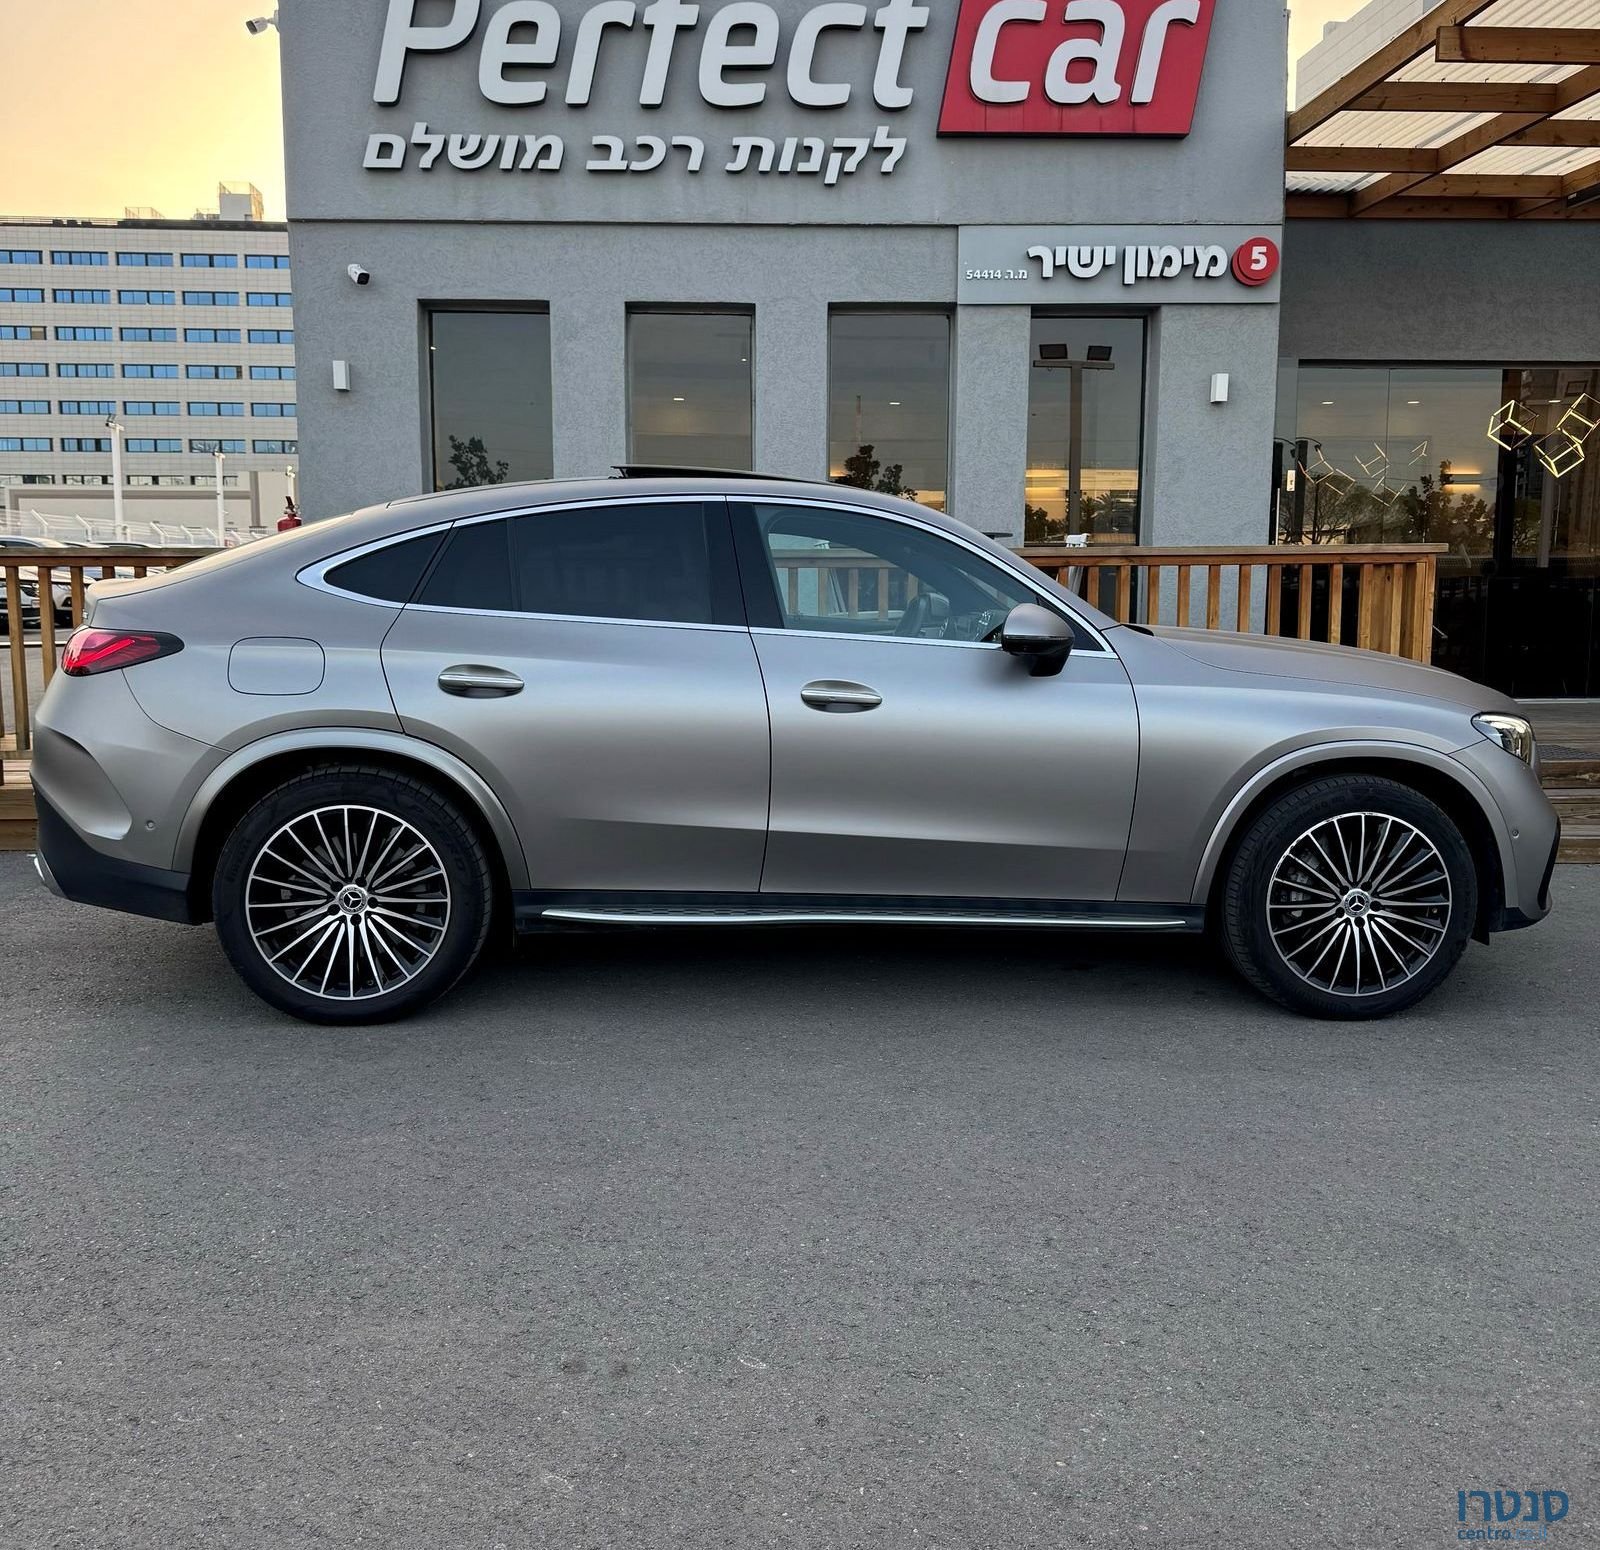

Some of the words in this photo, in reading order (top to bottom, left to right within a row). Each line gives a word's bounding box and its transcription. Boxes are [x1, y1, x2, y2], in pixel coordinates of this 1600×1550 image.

[373, 0, 930, 107] Perfect
[968, 0, 1200, 105] car
[362, 122, 565, 171] מושלם
[586, 135, 704, 173] רכב
[725, 125, 907, 186] לקנות
[965, 269, 1002, 280] 54414
[1026, 245, 1117, 279] ישיר
[1122, 245, 1228, 285] מימון
[1250, 246, 1268, 270] 5
